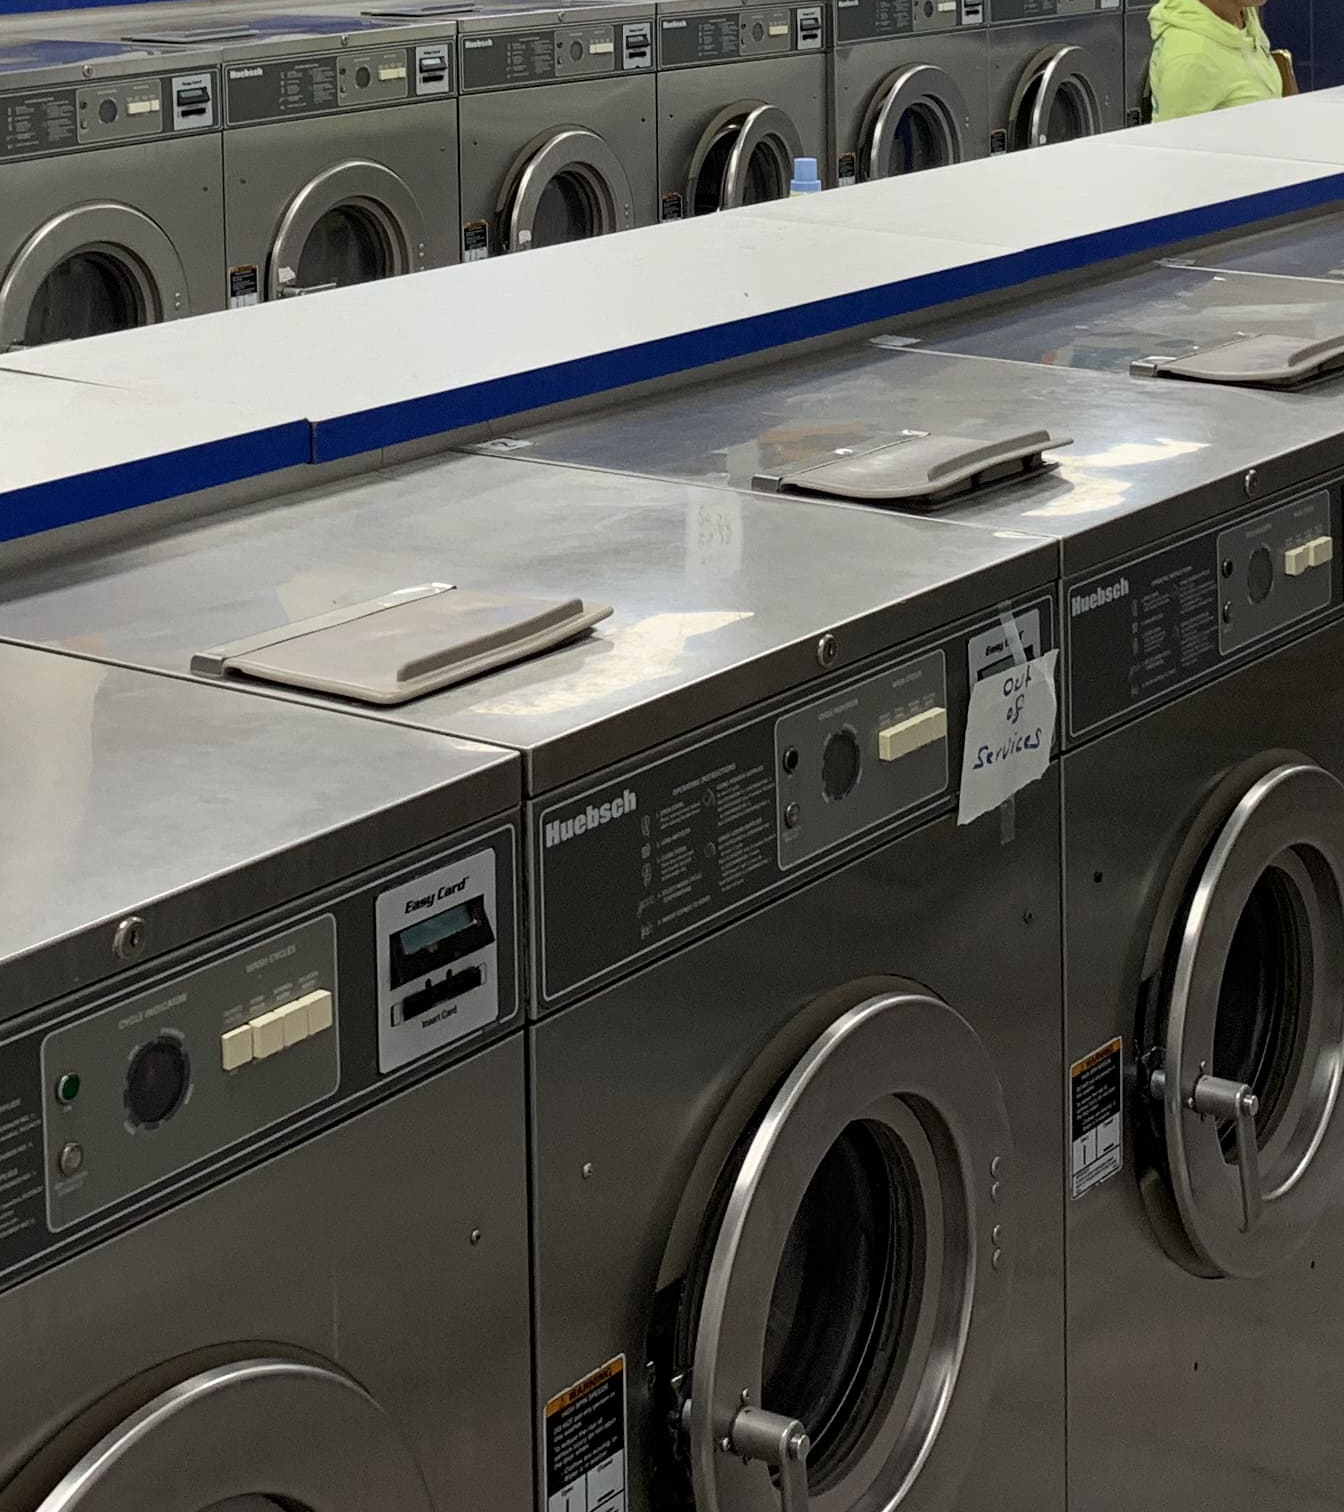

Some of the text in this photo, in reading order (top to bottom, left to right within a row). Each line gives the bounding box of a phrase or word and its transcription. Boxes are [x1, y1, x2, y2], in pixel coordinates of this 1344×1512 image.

[1070, 576, 1129, 618] Huebsch
[1003, 663, 1032, 697] Out
[1006, 693, 1025, 725] of
[972, 727, 1042, 770] Services
[545, 788, 638, 849] Huebsch
[405, 876, 467, 914] Easy Card
[422, 1004, 459, 1029] Insert Card
